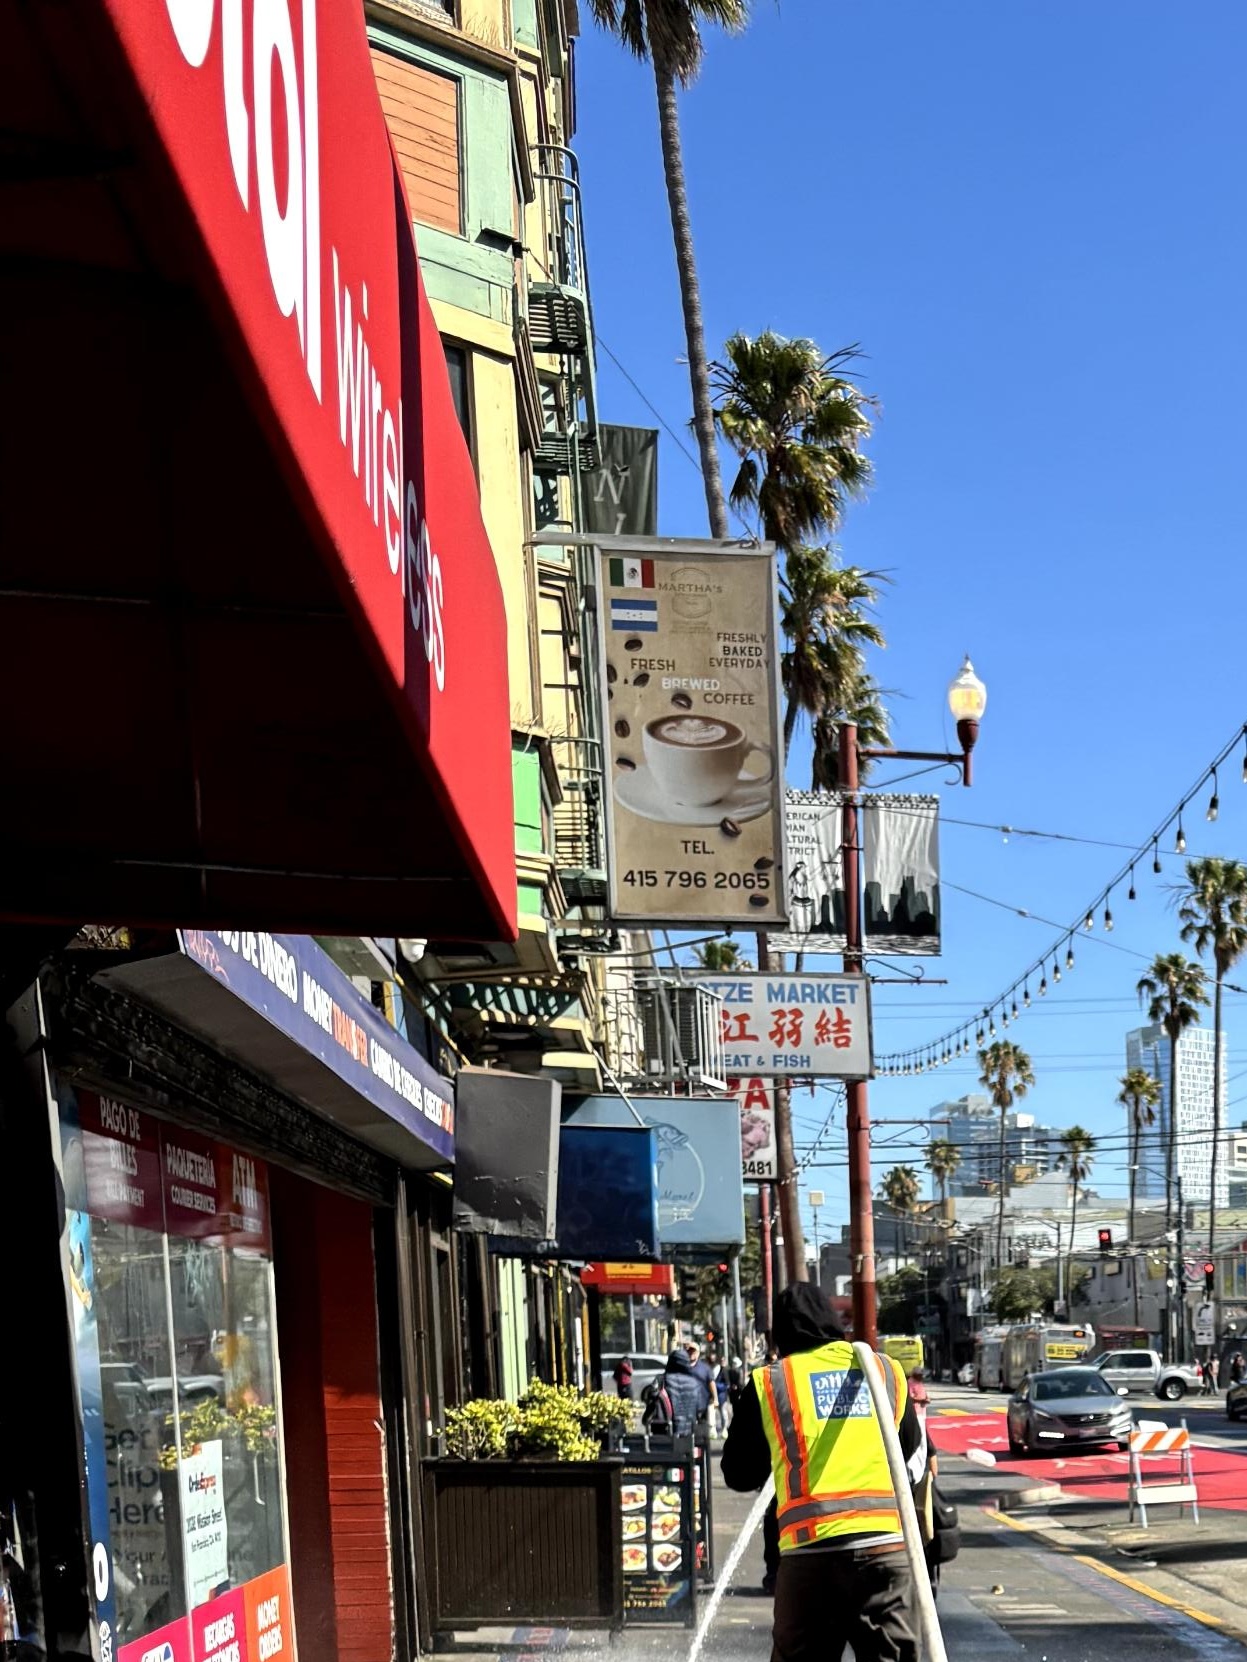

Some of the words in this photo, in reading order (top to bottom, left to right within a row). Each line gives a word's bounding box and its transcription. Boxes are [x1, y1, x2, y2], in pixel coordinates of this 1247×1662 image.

[716, 632, 768, 644] FRESHLY
[722, 646, 763, 657] BAKED
[630, 658, 676, 671] FRESH
[709, 657, 772, 669] EVERYDAY
[661, 677, 721, 691] BREWED
[702, 693, 755, 705] COFFEE
[680, 840, 715, 855] TEL.
[623, 870, 658, 888] 415
[664, 871, 707, 889] 796
[714, 872, 770, 890] 2065
[767, 982, 860, 1004] MARKET
[302, 970, 333, 1035] MONEY
[756, 1054, 766, 1067] &
[773, 1055, 811, 1068] FISH
[101, 1096, 127, 1136] PAGO
[129, 1111, 141, 1141] DE
[166, 1143, 216, 1189] PAQUETERÍA
[232, 1154, 258, 1211] ATM
[817, 1393, 869, 1405] PUBLIC
[818, 1404, 869, 1416] WORKS
